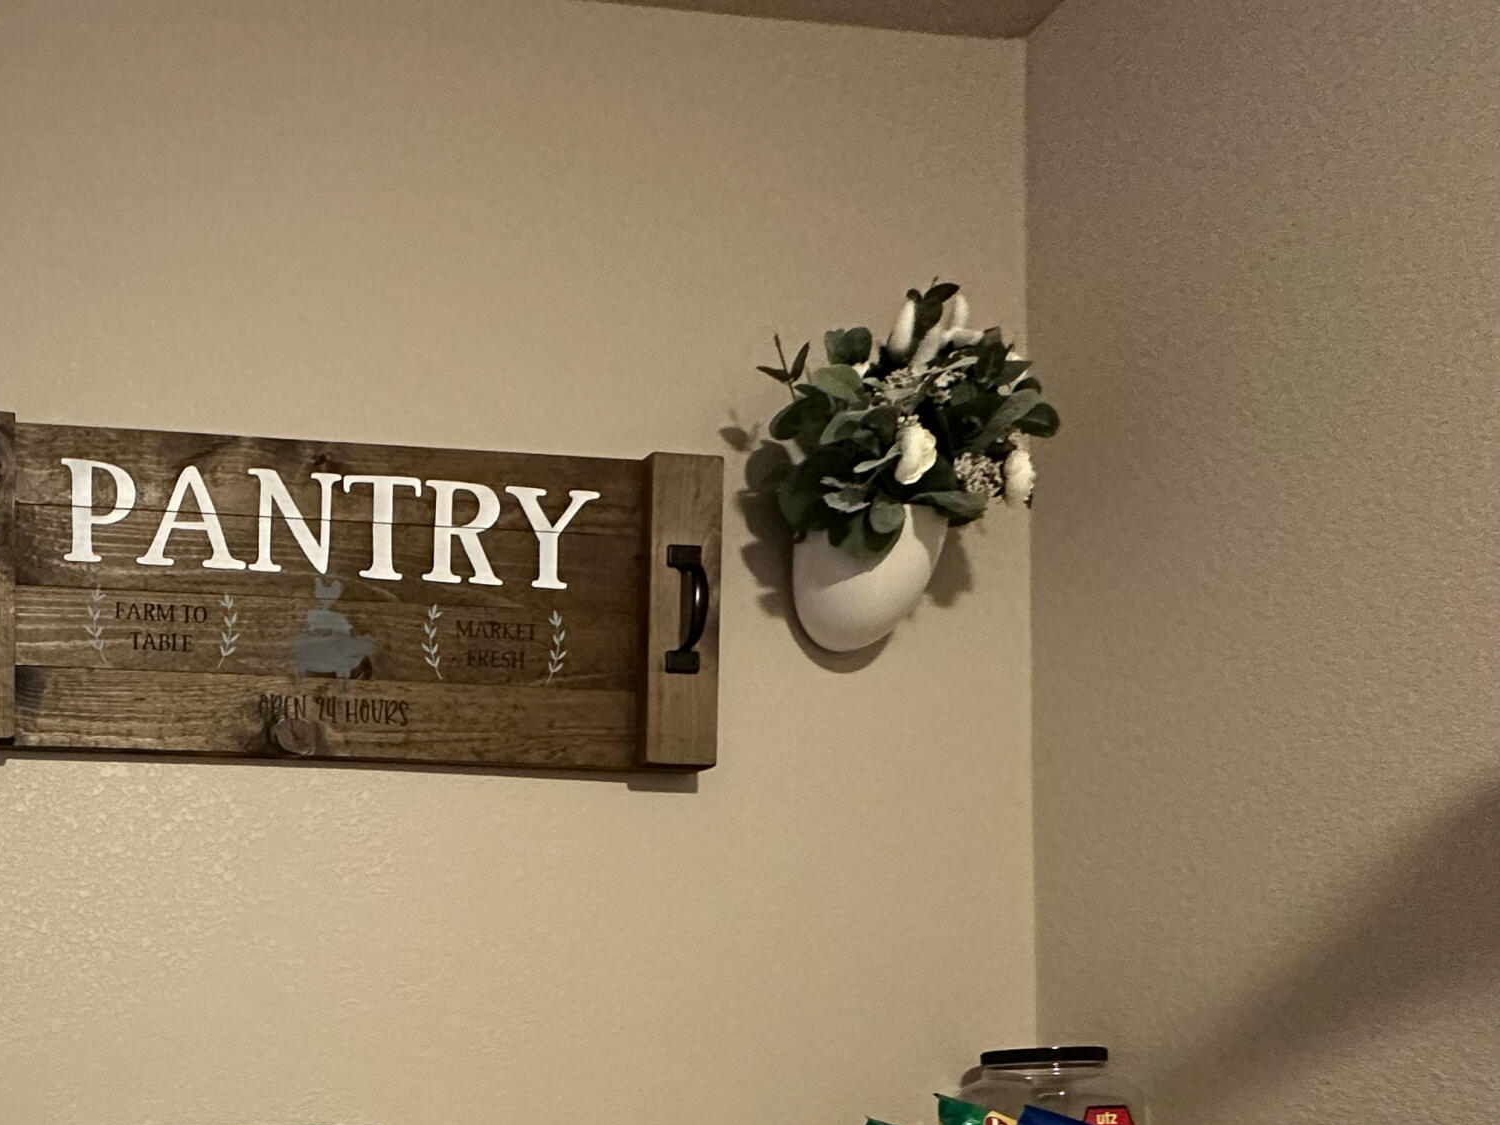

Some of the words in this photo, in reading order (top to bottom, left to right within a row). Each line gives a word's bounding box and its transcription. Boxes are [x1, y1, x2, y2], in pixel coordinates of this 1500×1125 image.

[61, 457, 601, 590] PANTRY
[115, 602, 174, 622] FARM
[181, 605, 208, 623] TO
[455, 620, 537, 640] MARKET
[130, 632, 192, 651] TABLE
[466, 650, 525, 669] FRESH
[258, 694, 306, 720] OPEN
[345, 699, 410, 727] HOURS
[1096, 1111, 1119, 1125] utz
